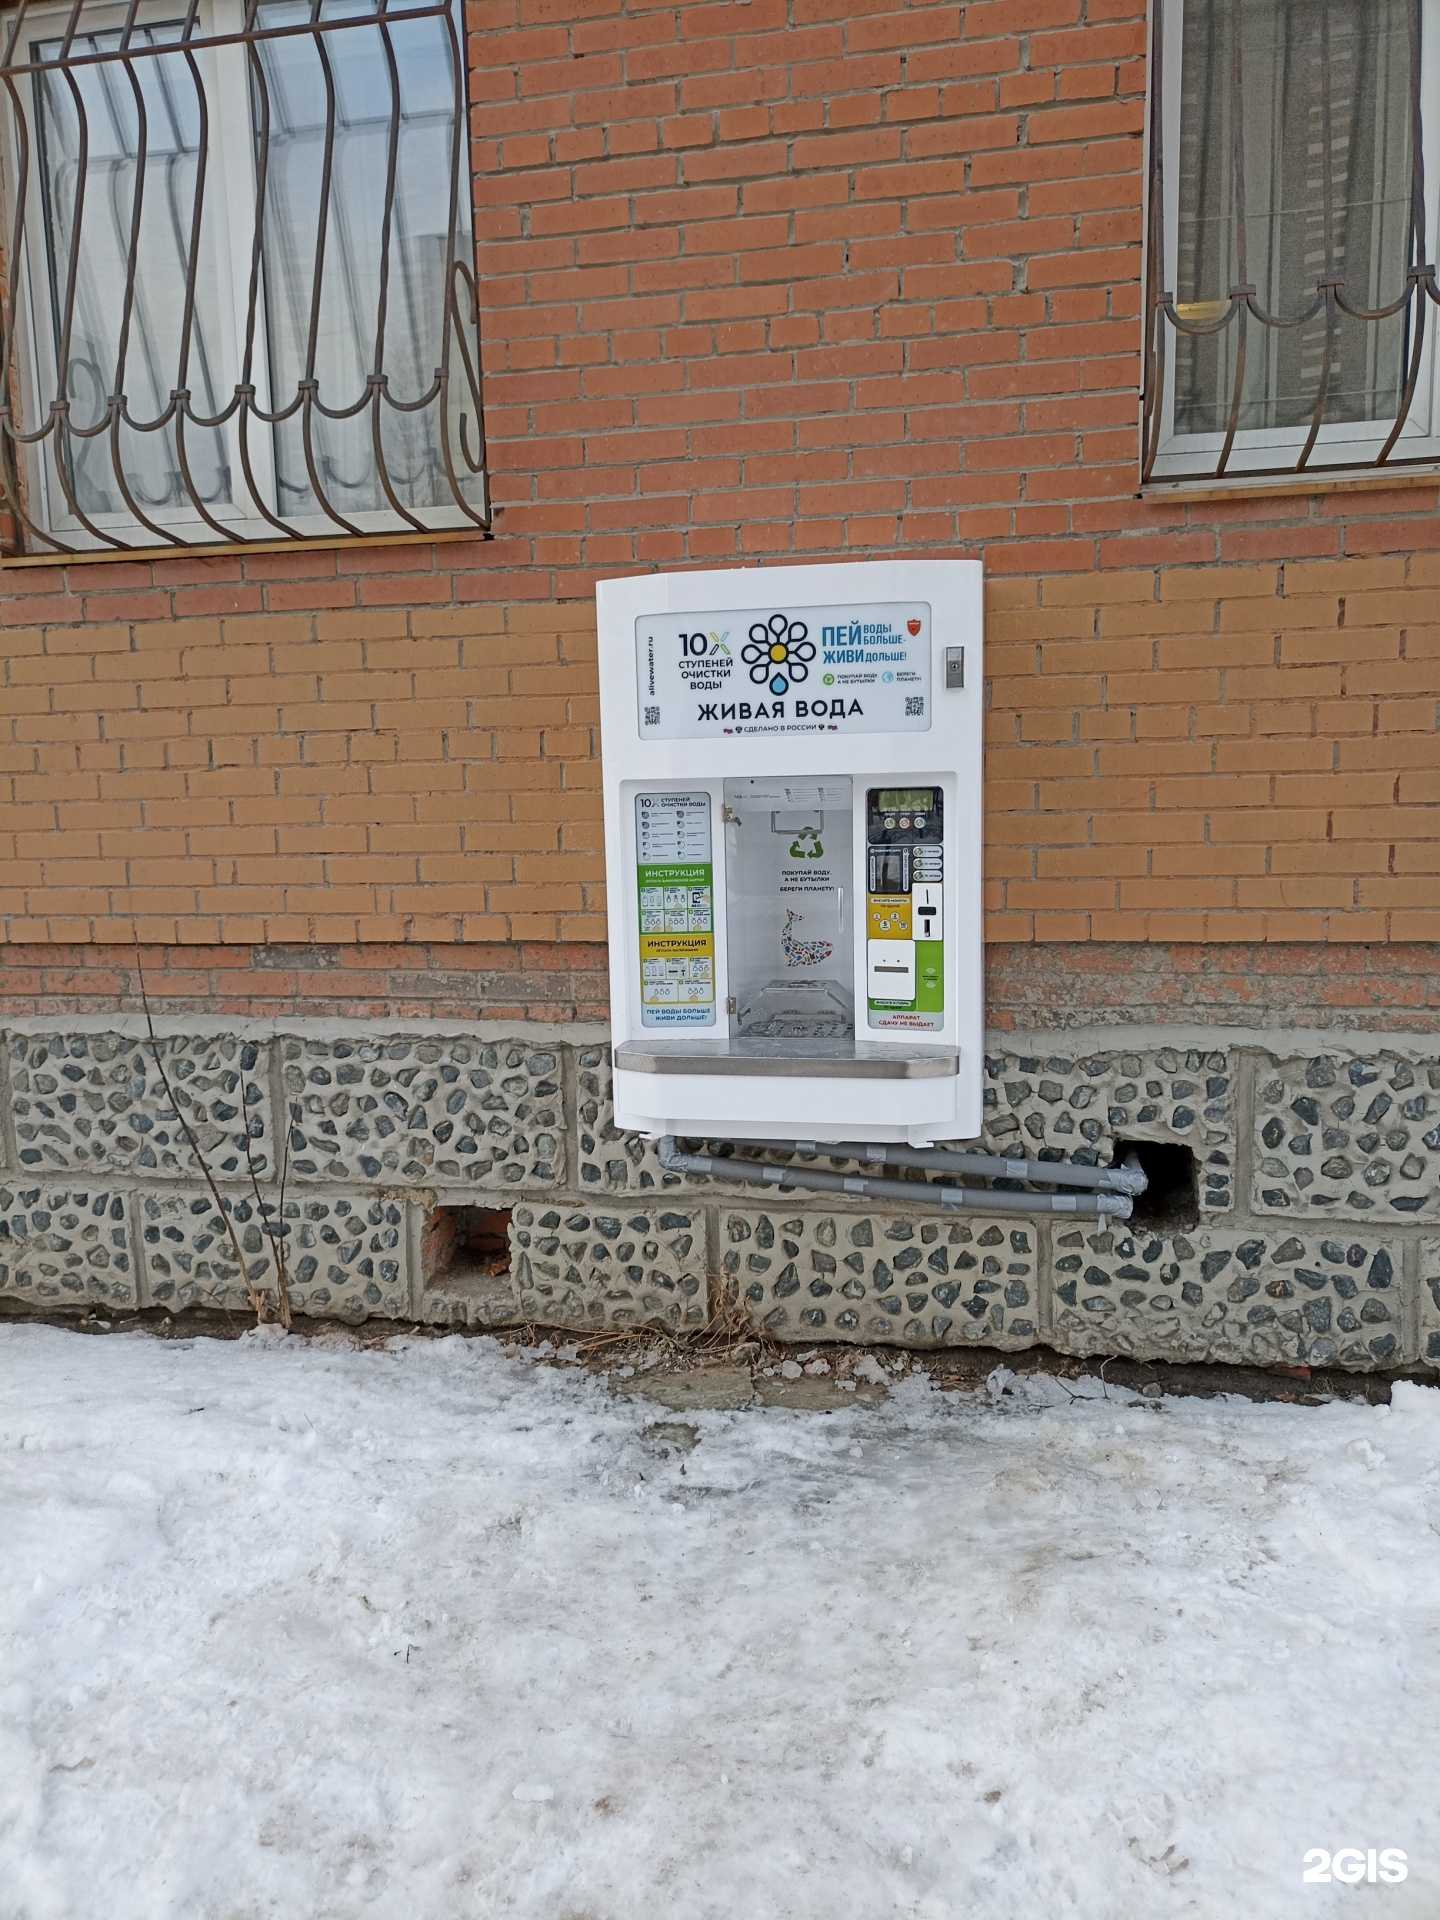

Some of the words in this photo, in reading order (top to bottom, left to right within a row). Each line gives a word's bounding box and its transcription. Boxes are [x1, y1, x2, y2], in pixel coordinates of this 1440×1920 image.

[822, 620, 861, 647] ПЕЙ
[863, 624, 892, 634] ВОДЫ
[823, 649, 864, 664] ЖИВИ
[865, 651, 907, 662] ДОЛЬШЕ!
[678, 657, 734, 669] СТУПЕНЕЙ
[681, 669, 731, 679] ОЧИСТКИ
[690, 681, 722, 690] ВОДЫ
[697, 701, 785, 721] ЖИВАЯ
[795, 698, 864, 719] ВОДА
[744, 725, 779, 733] СДЕЛАНО
[645, 869, 705, 878] ИНСТРУКЦИЯ
[647, 939, 707, 948] ИНСТРУКЦИЯ
